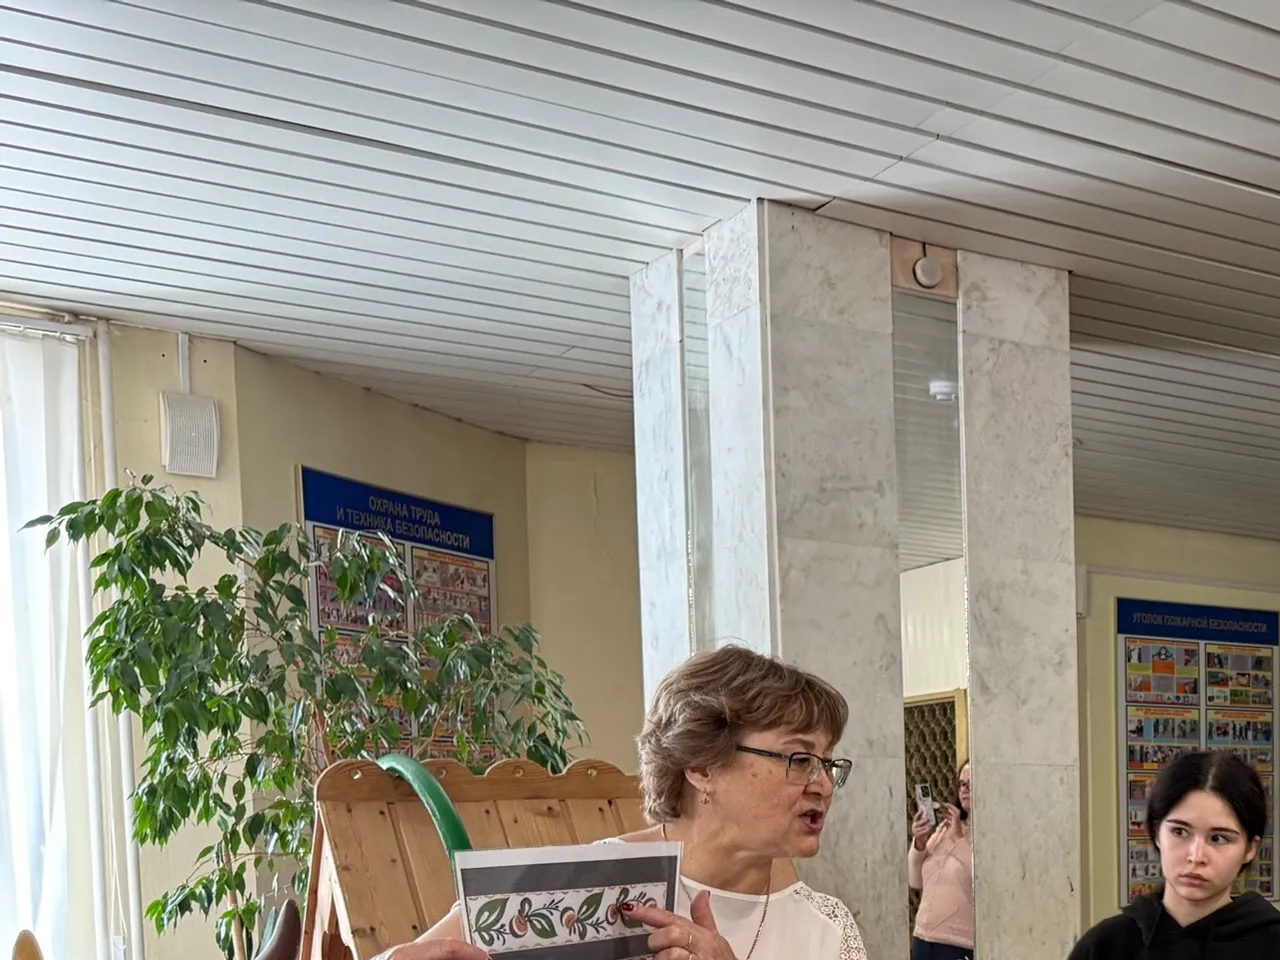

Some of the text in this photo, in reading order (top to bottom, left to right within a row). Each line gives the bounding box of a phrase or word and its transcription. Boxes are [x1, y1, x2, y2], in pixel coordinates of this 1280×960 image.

[369, 496, 441, 525] ОХРАНА ТРУДА
[336, 506, 345, 520] И
[346, 508, 393, 531] ТЕХНИКА
[395, 521, 470, 549] БЕЗОПАСНОСТИ
[1132, 612, 1267, 633] УГОЛОК ПОЖАРНОЙ БЕЗОПАСНОСТИ
